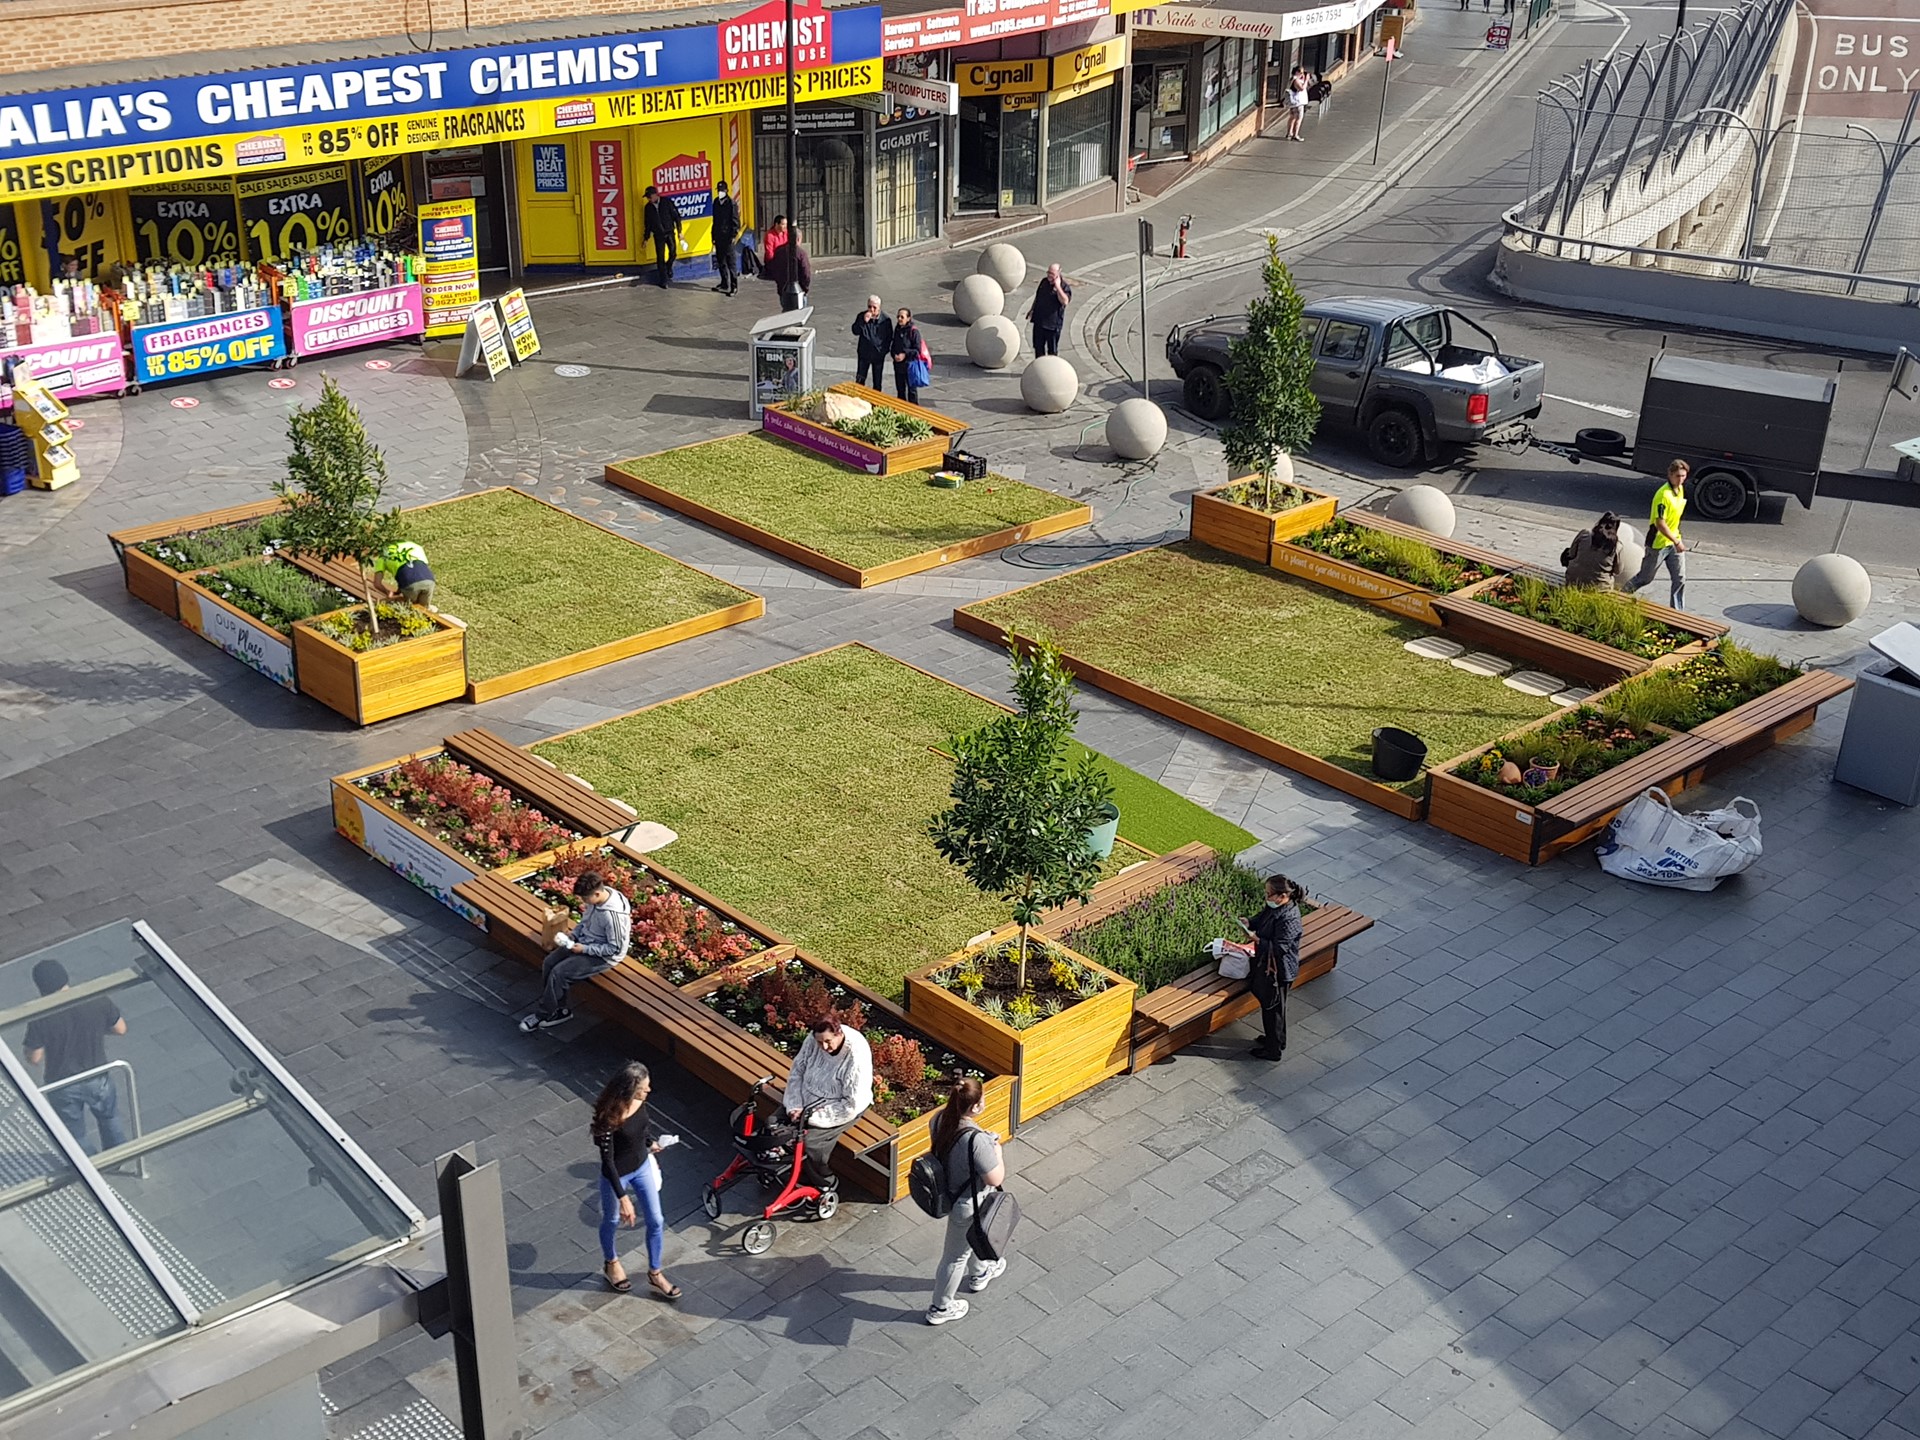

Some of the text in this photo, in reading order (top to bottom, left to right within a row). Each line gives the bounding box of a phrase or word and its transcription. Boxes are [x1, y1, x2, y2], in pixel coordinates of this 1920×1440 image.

[1157, 11, 1197, 28] Nails
[1201, 17, 1215, 29] &
[1219, 15, 1274, 39] Beauty
[1835, 33, 1909, 58] BUS
[727, 46, 827, 71] WAREHUSE
[1074, 46, 1106, 77] Cignall
[197, 62, 448, 124] CHEAPEST
[470, 41, 663, 95] CHEMIST
[970, 63, 1034, 91] Cignall
[1818, 65, 1920, 94] ONLY
[608, 94, 636, 118] WE
[642, 89, 685, 114] BEAT
[691, 73, 802, 108] EVERYONES
[808, 65, 872, 93] PRICES
[898, 82, 947, 104] COMPUTERS
[1004, 93, 1037, 108] Cignall
[302, 108, 525, 156] UP TO 85% OFF GENUINE DESIGNER FRAGRANCES
[880, 130, 929, 150] GIGABYTE
[536, 159, 563, 172] BEAT
[540, 147, 558, 160] WE
[0, 143, 224, 193] RESCRIPTIONS
[656, 163, 709, 184] CHEMIST
[239, 170, 344, 193] SALE! SALE! SALE! SALE!
[370, 170, 394, 194] EXTRA
[537, 178, 565, 187] PRICES
[657, 179, 710, 193] WAREHOUSE
[268, 193, 323, 215] EXTRA
[597, 144, 620, 246] OPEN 7 DAYS
[157, 200, 210, 218] EXTRA
[139, 219, 237, 267] 10%
[250, 207, 349, 263] 10%
[425, 282, 475, 294] ORDER NOW
[308, 291, 408, 326] DISCOUNT
[150, 315, 264, 349] FRAGRANCES
[308, 313, 409, 347] FRAGRANCES
[516, 332, 533, 346] NOW
[146, 335, 275, 377] UP TO 85% OFF
[488, 350, 503, 363] NOW
[518, 341, 537, 355] OPEN
[766, 353, 783, 362] BIN
[490, 358, 507, 371] OPEN
[1280, 550, 1289, 562] To
[1289, 555, 1307, 566] plant
[1308, 563, 1314, 571] a
[1314, 564, 1341, 580] garden
[1340, 573, 1347, 582] is
[215, 613, 237, 634] OUR
[237, 627, 264, 659] Place
[1665, 846, 1700, 870] MARTINS
